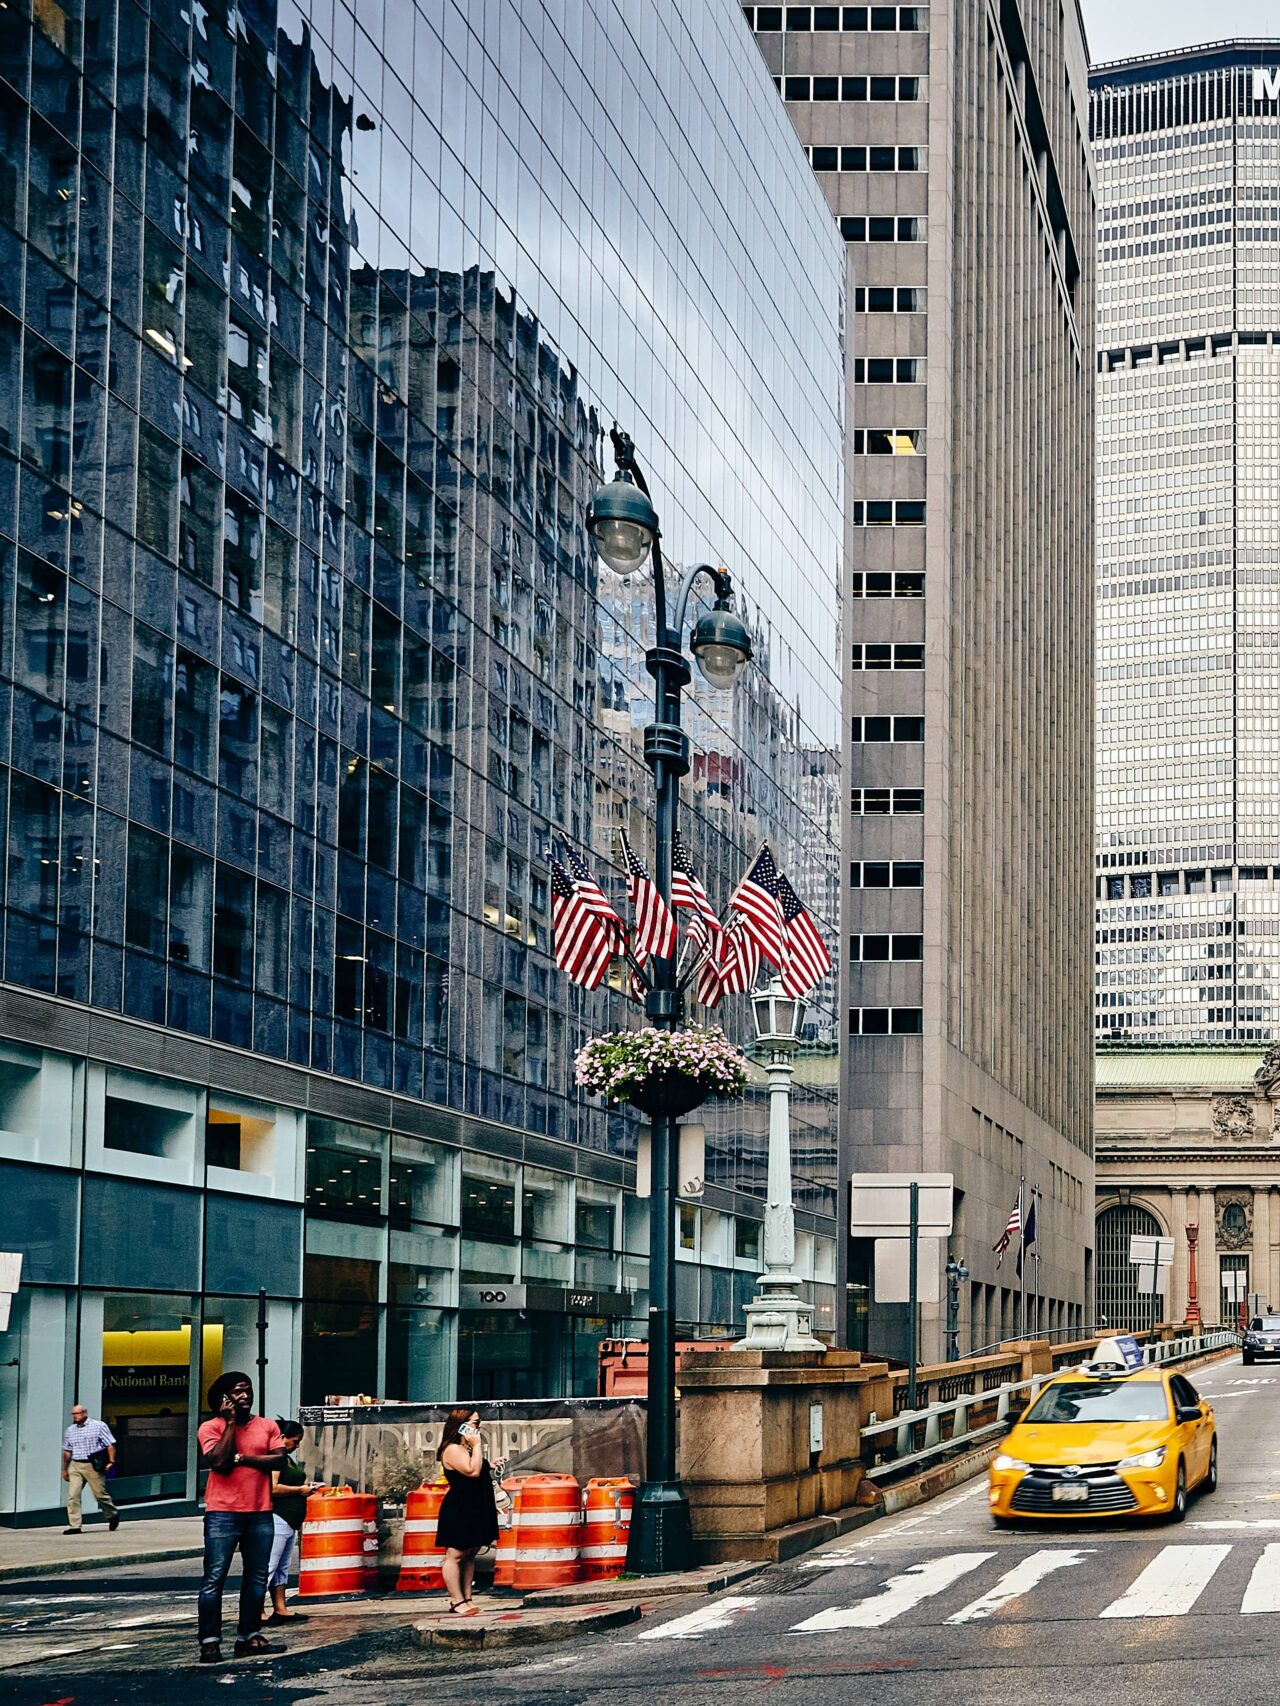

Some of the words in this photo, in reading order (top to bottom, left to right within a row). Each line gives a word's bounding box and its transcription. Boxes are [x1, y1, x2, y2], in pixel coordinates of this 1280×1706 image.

[479, 1290, 507, 1303] 100
[109, 1375, 156, 1388] National
[159, 1374, 190, 1387] Bank
